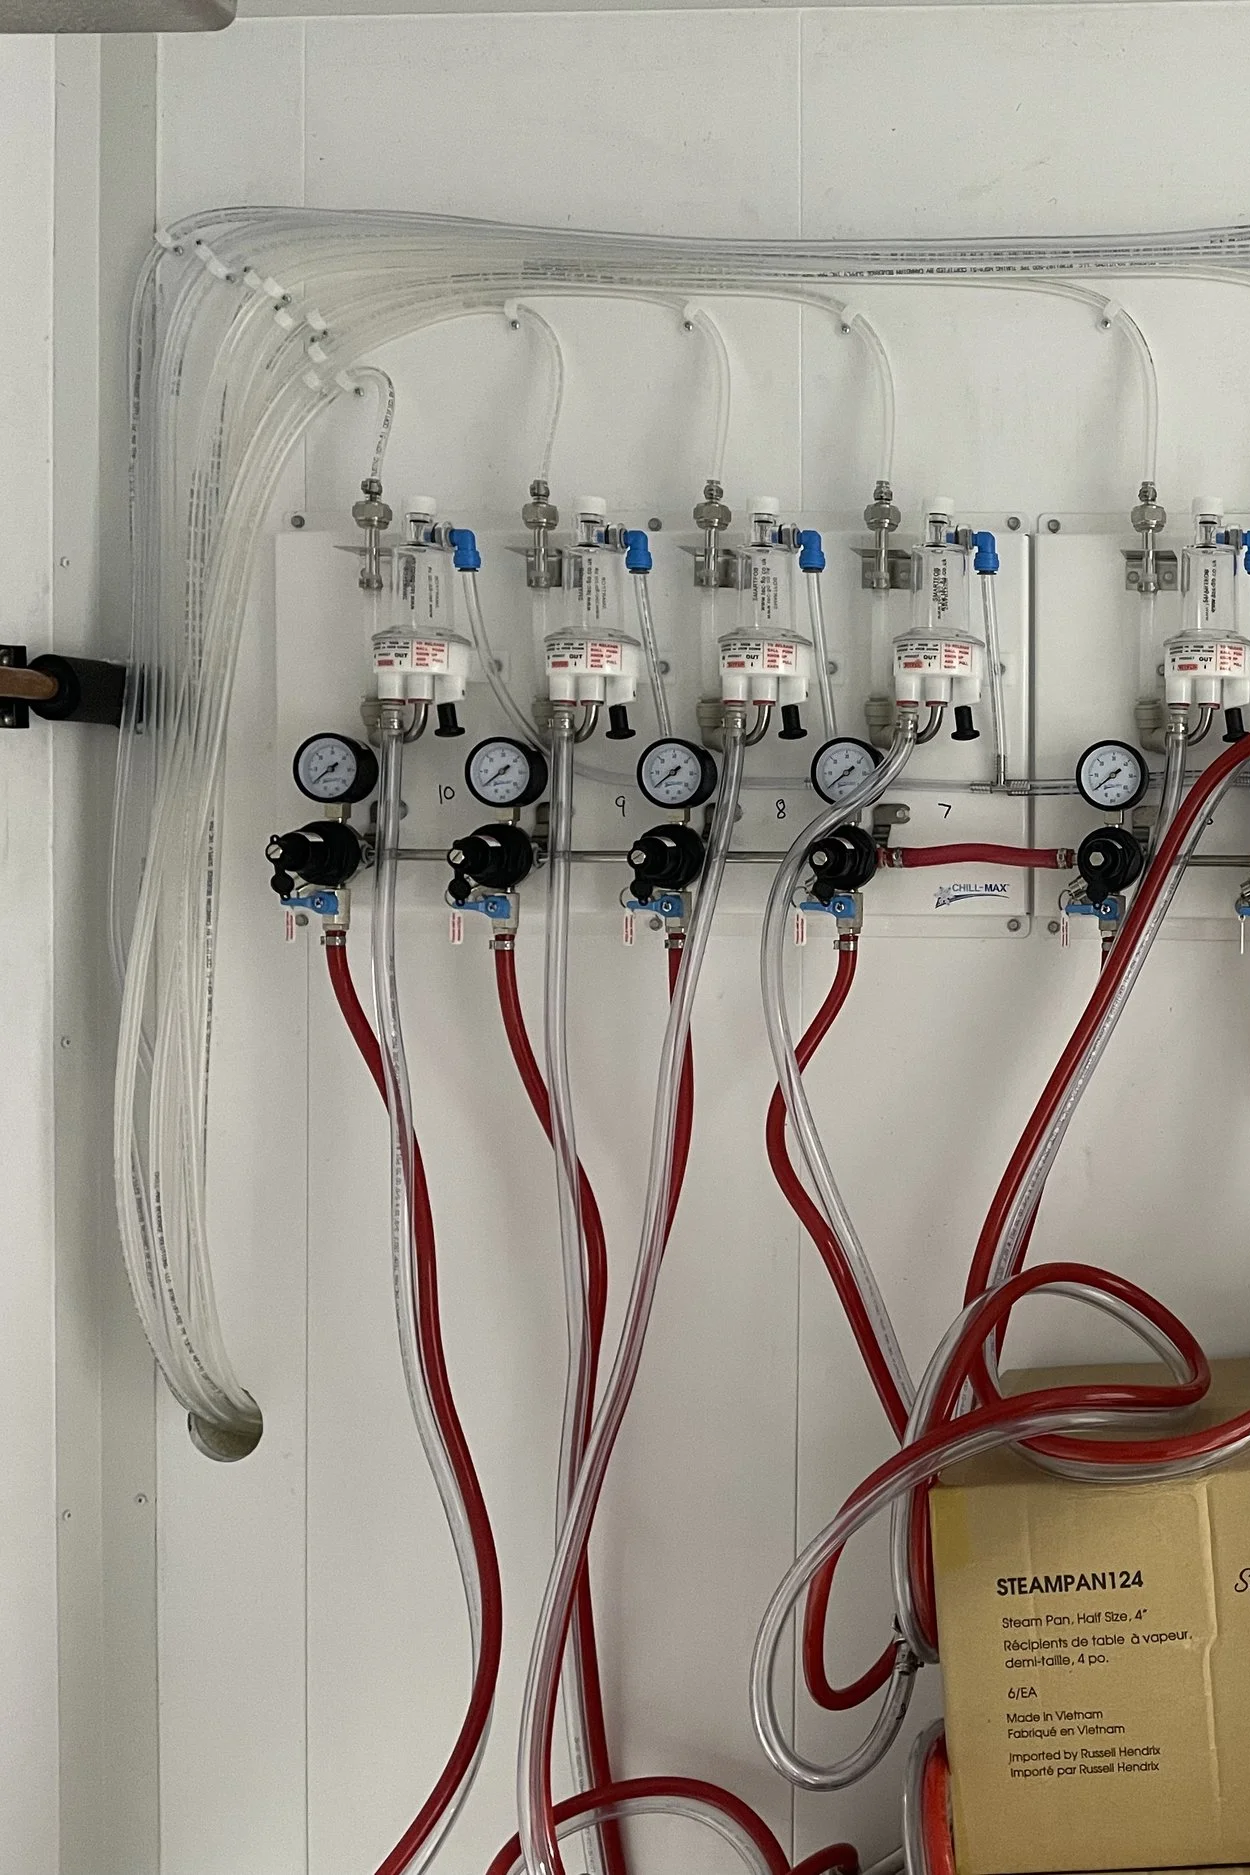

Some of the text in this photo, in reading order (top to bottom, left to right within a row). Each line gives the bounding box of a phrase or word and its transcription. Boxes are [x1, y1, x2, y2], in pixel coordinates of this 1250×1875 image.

[438, 784, 455, 804] 10
[615, 795, 626, 817] 9
[776, 798, 786, 819] 8
[938, 803, 952, 819] 7
[952, 883, 1008, 892] CHILL-MAX
[996, 1570, 1144, 1596] STEAMPAN124
[1002, 1617, 1042, 1628] Steam
[1046, 1615, 1074, 1627] Pan,
[1077, 1612, 1102, 1624] Half
[1003, 1637, 1068, 1652] Récipients
[1071, 1636, 1089, 1648] de
[1092, 1634, 1125, 1647] table
[1130, 1633, 1140, 1645] à
[1005, 1653, 1109, 1669] demi-taille, 4 po.
[1007, 1686, 1038, 1700] 6/EA
[1006, 1710, 1104, 1723] Made in Vietnam
[1007, 1724, 1126, 1739] Fabriqué en Vietnam
[1008, 1745, 1161, 1765] Imported by Russell Hendrix
[1010, 1761, 1160, 1778] Importé par Russell Hendrix
